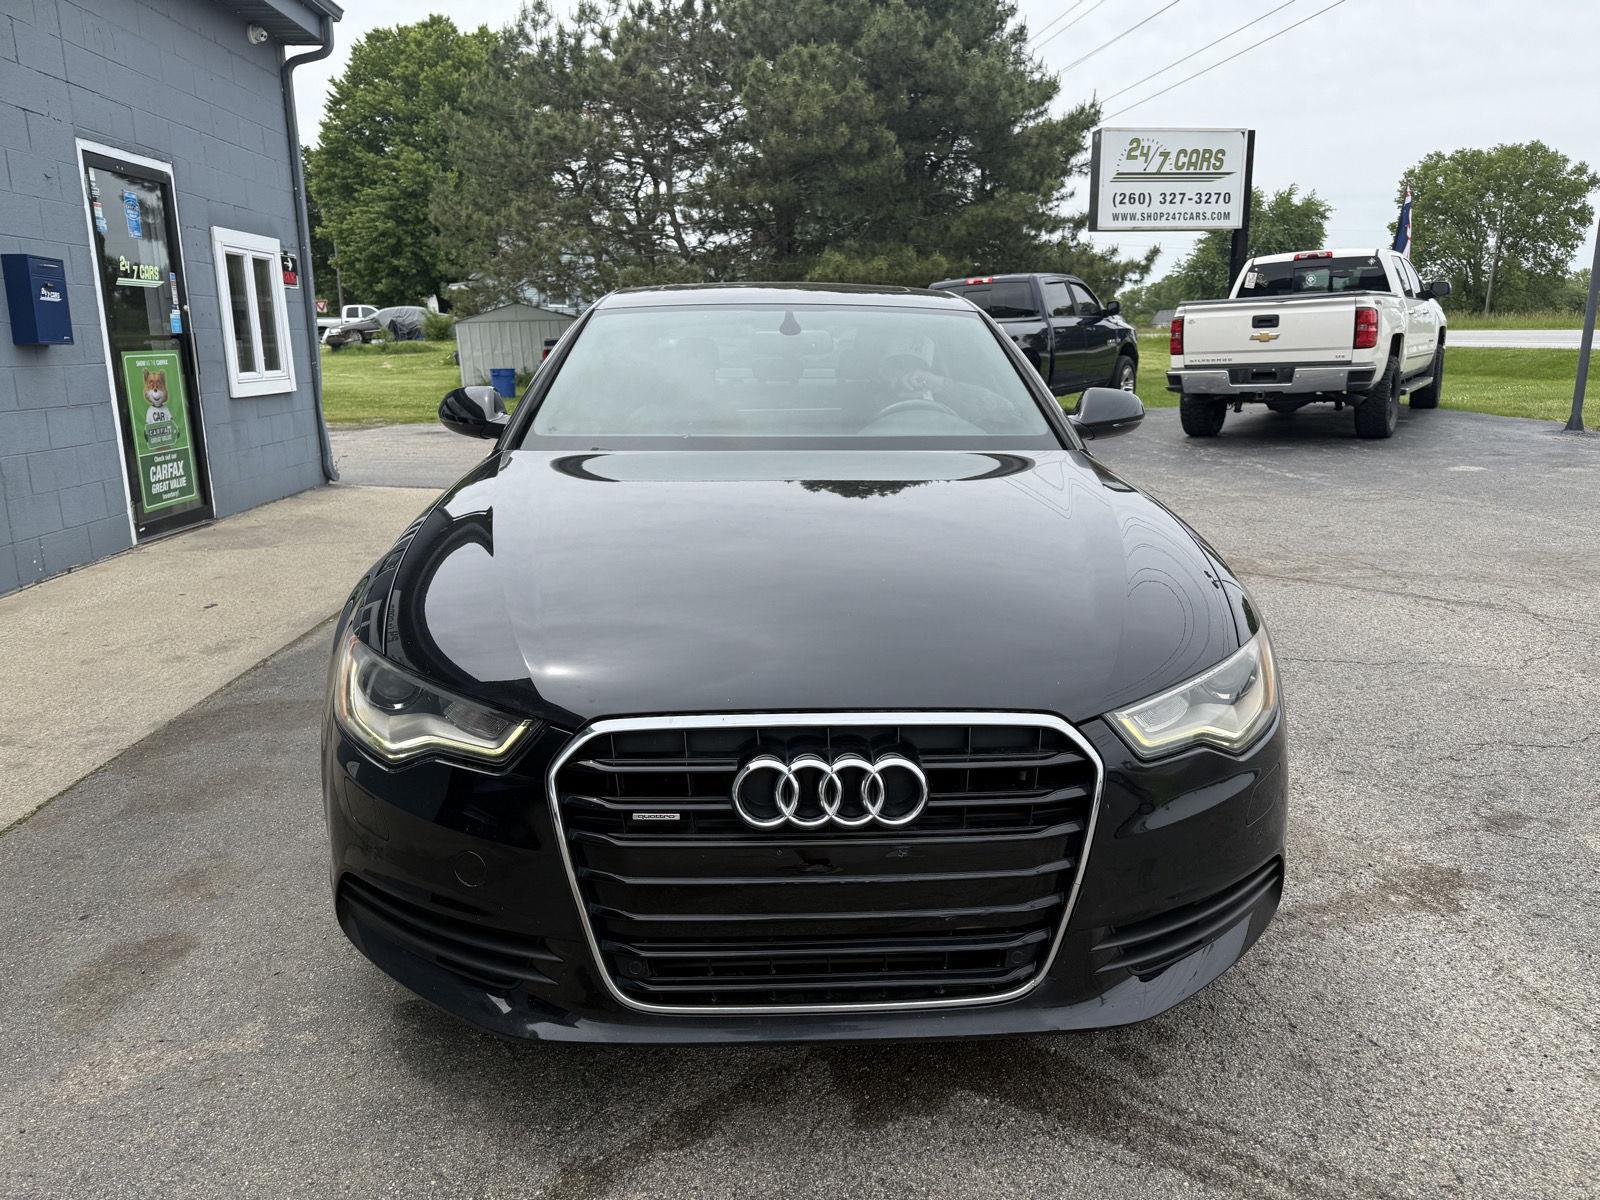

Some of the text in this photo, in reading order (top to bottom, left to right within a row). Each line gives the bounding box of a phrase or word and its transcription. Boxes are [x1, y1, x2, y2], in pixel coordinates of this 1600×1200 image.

[1126, 137, 1226, 173] 24/7 CARS
[1112, 192, 1231, 208] (260) 327-3270
[1112, 211, 1231, 222] WWW.SHOP247CARS.COM
[140, 265, 159, 280] CARS
[153, 411, 165, 421] CAR
[150, 460, 184, 482] CARFAX
[152, 477, 187, 494] GREAT VALUE
